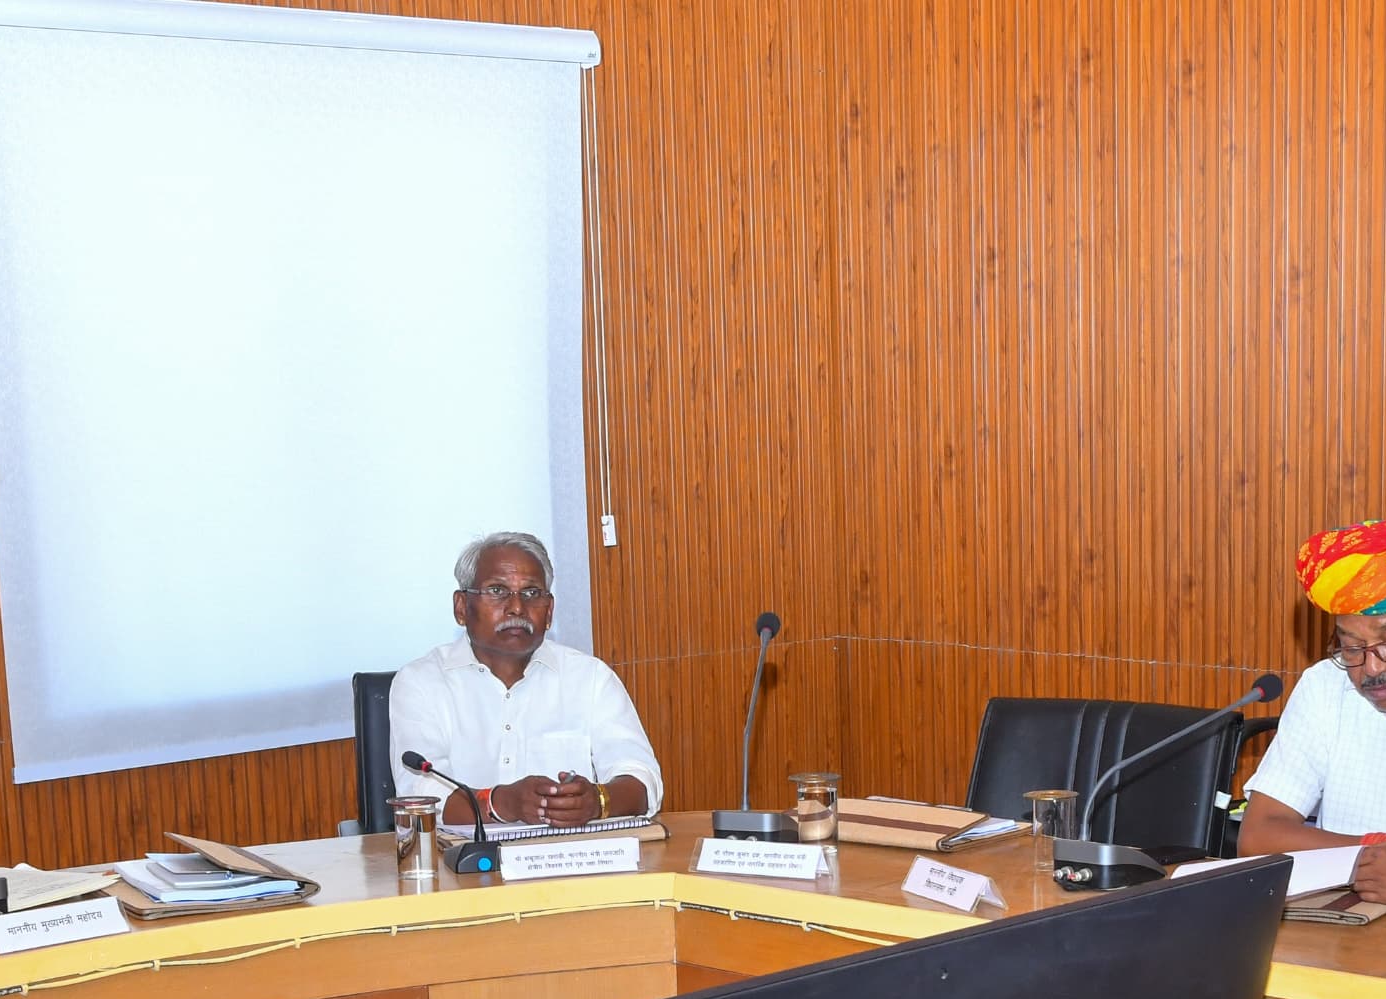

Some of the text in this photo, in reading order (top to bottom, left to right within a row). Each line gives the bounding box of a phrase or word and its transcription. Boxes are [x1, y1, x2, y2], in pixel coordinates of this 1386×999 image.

[7, 910, 103, 935] माननीय मुख्यमंत्री महोदय
